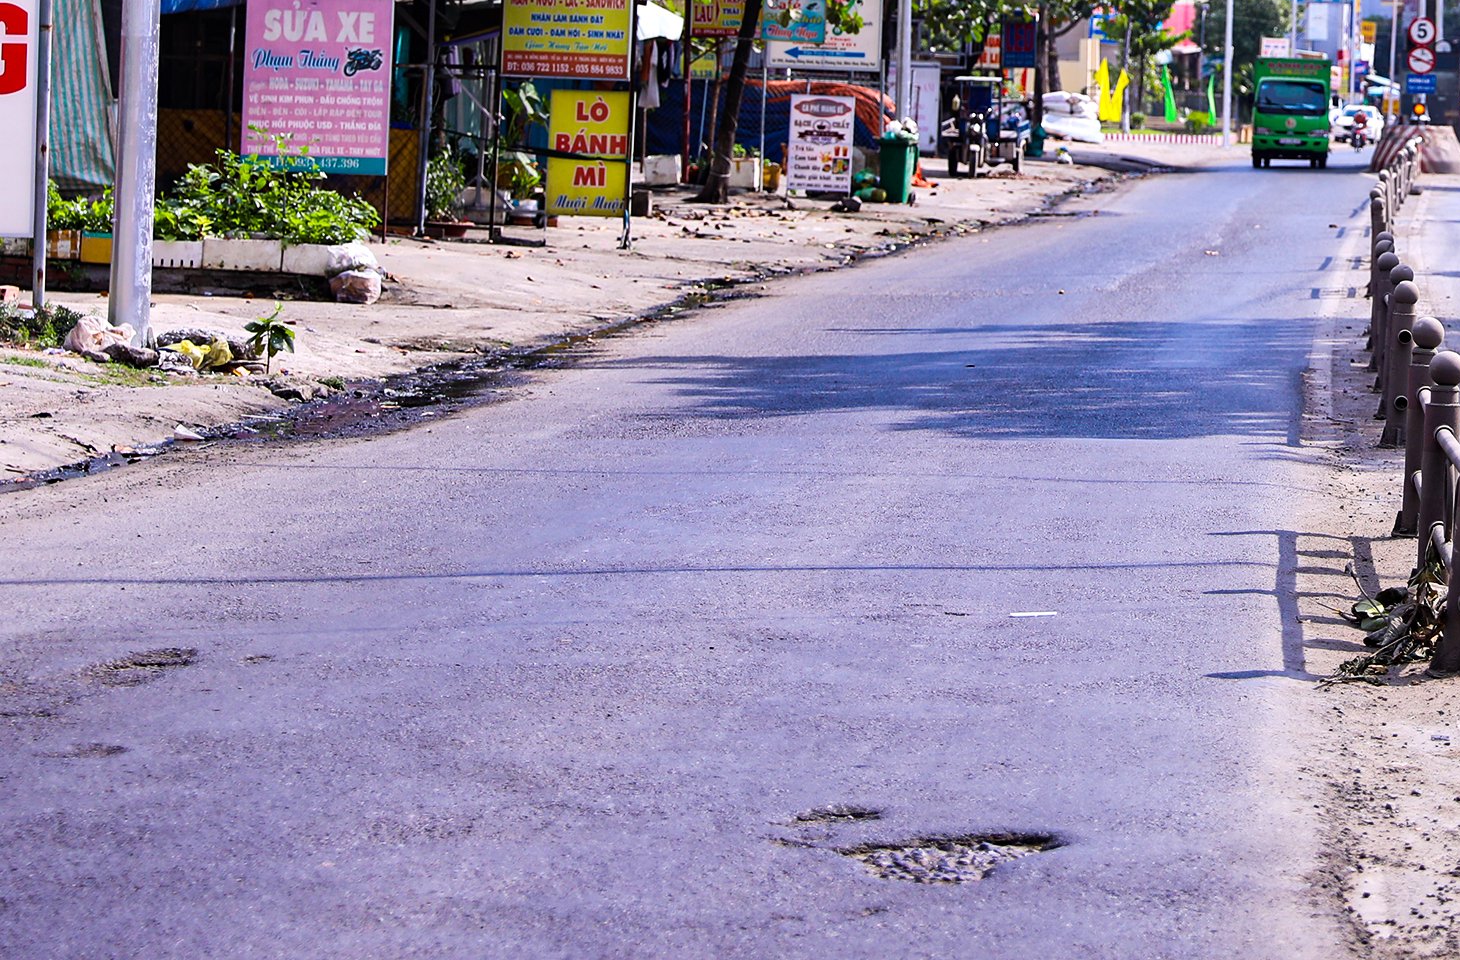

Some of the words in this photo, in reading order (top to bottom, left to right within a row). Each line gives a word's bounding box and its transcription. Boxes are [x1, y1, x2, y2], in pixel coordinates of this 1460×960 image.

[336, 11, 375, 43] XE
[1417, 23, 1427, 39] 5
[575, 96, 610, 122] LÒ
[555, 128, 628, 156] BÁNH
[573, 160, 606, 188] MÌ
